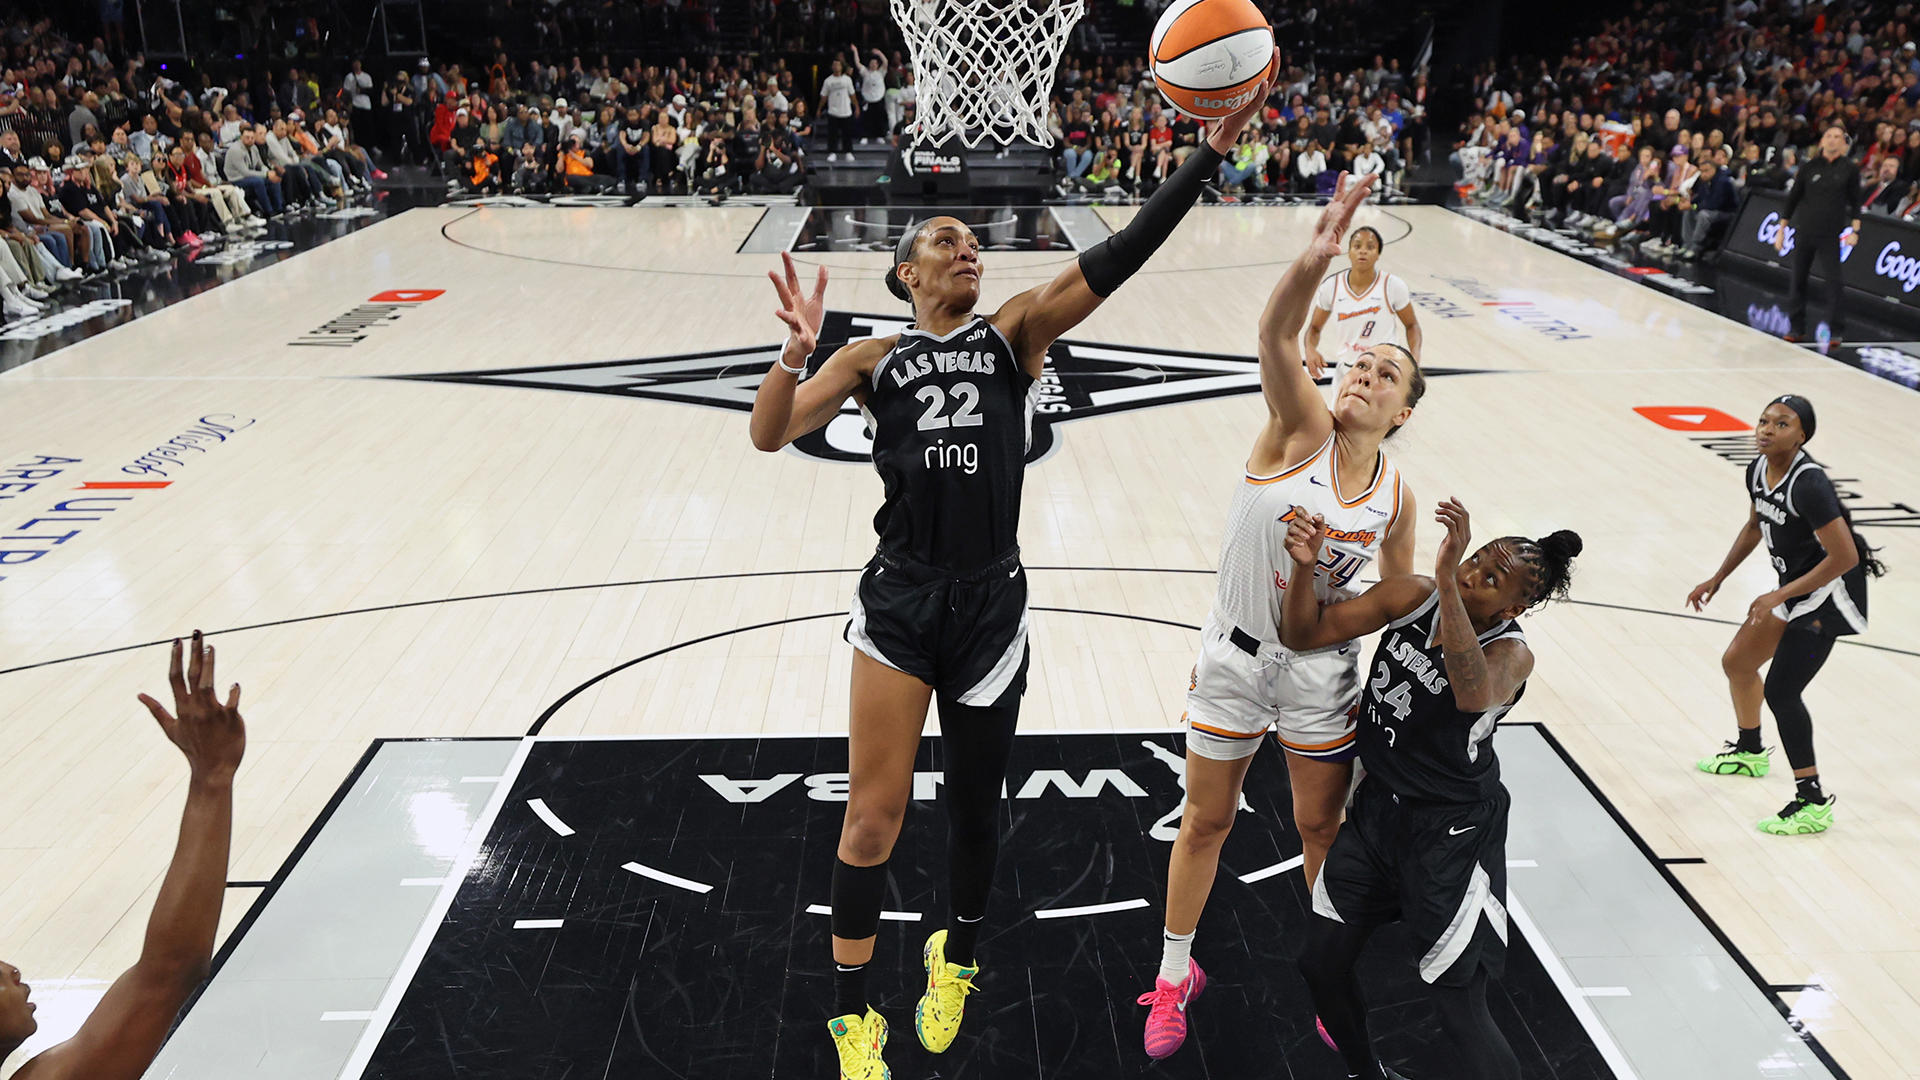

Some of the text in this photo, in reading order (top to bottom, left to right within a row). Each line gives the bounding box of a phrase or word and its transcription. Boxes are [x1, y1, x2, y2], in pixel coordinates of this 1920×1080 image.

[914, 156, 960, 166] FINALS
[965, 327, 988, 343] ally
[1360, 320, 1376, 339] 8
[890, 350, 996, 388] LAS VEGAS
[914, 381, 984, 432] 22
[924, 438, 978, 475] ring
[0, 454, 83, 507] ARE
[0, 496, 134, 582] ULTR
[1314, 545, 1365, 590] 24
[1371, 660, 1413, 721] 24
[1401, 648, 1448, 695] VEGAS
